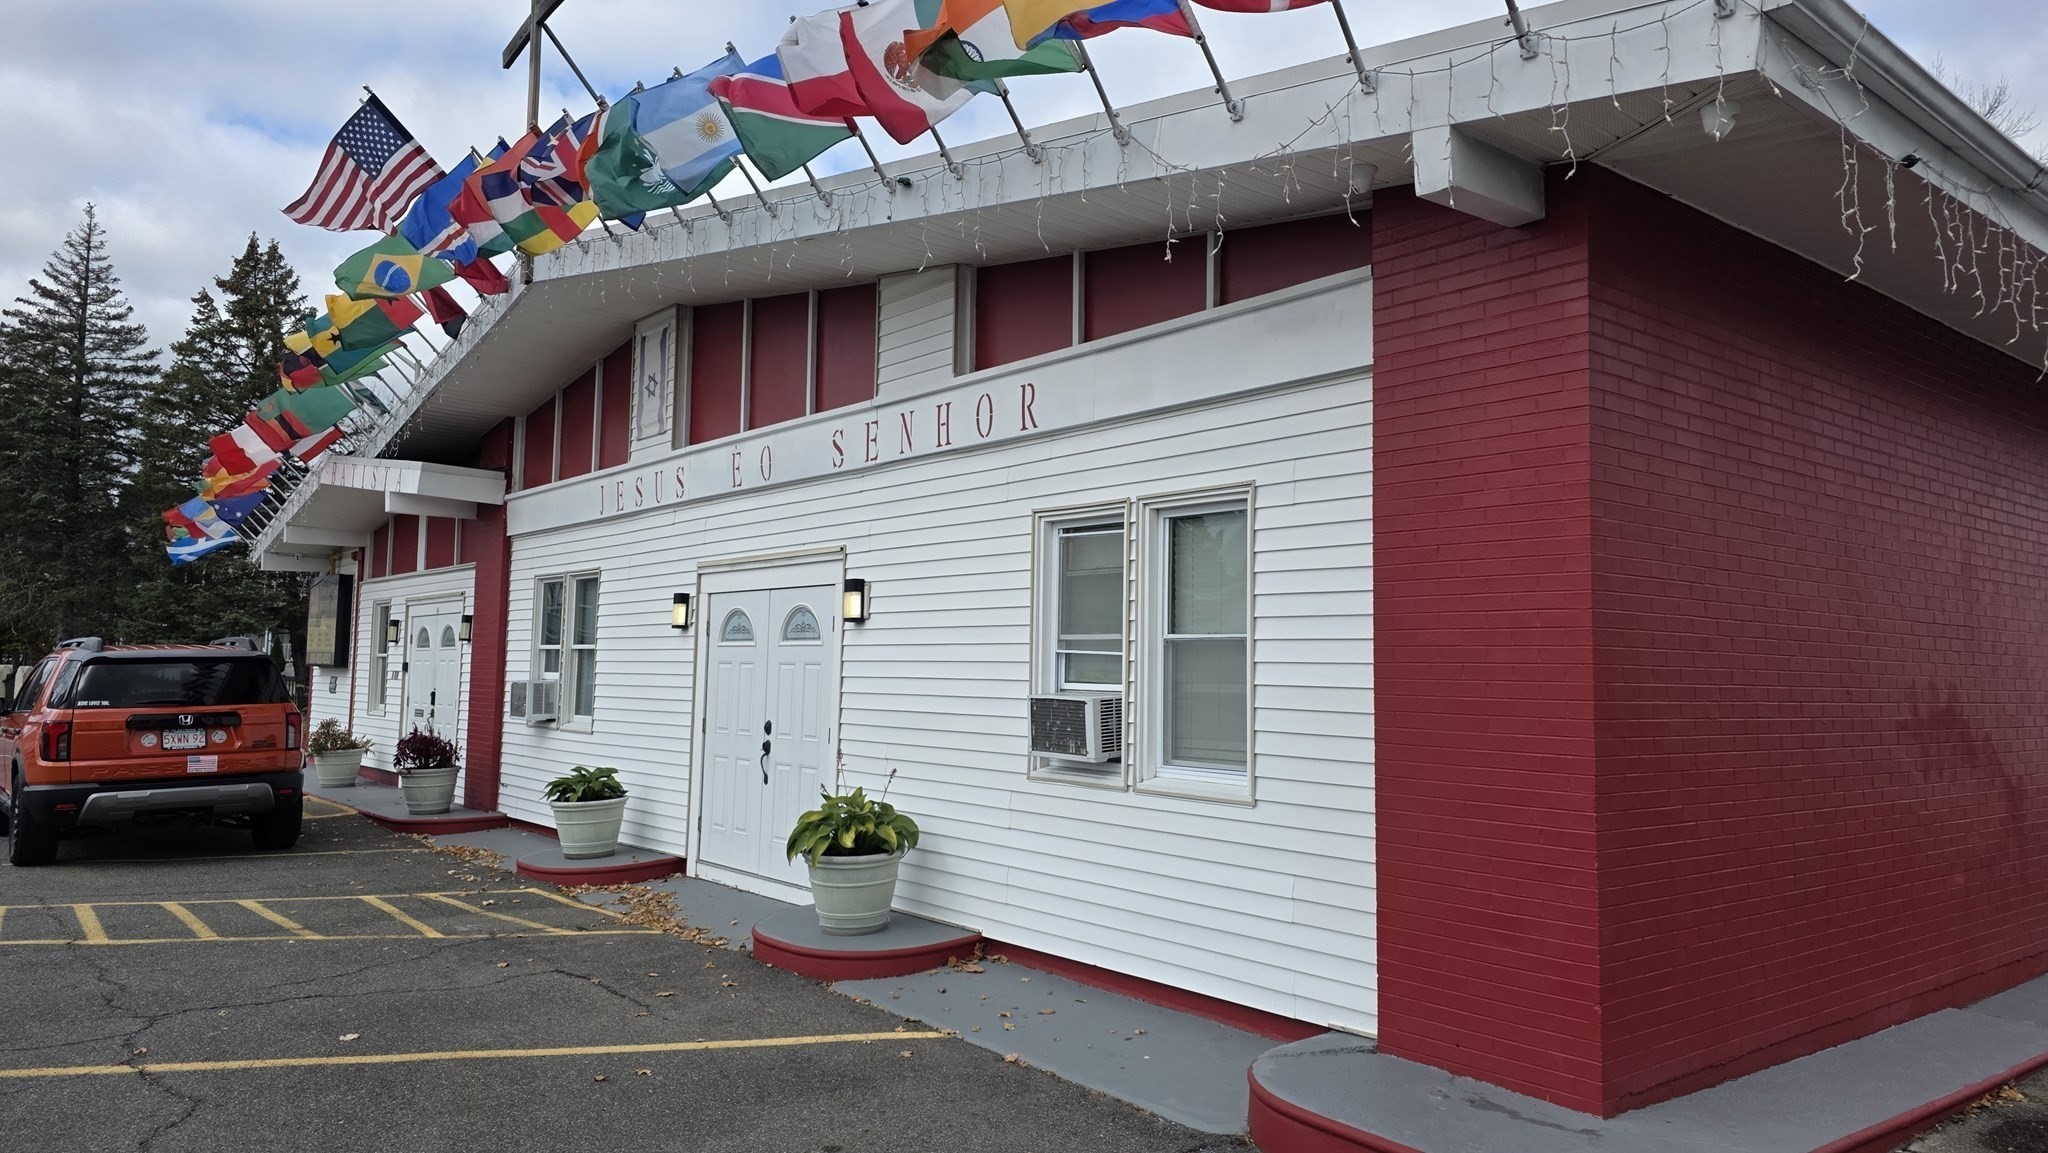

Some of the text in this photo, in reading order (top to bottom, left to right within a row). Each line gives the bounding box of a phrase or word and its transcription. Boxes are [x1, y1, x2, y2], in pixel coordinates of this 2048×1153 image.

[600, 466, 685, 515] JESUS
[831, 382, 1039, 469] SENHOR
[331, 461, 402, 492] BATISTA
[163, 733, 189, 745] 5XWN
[193, 733, 205, 744] 92
